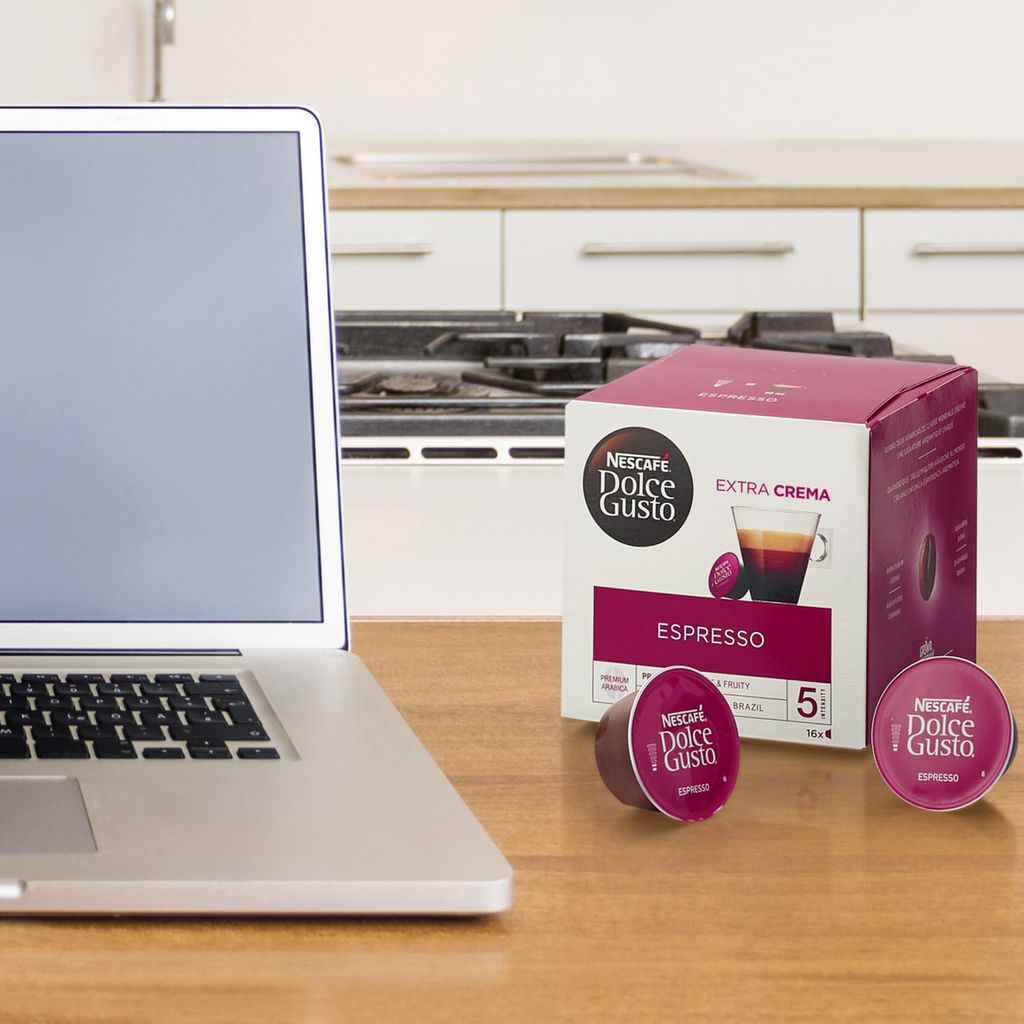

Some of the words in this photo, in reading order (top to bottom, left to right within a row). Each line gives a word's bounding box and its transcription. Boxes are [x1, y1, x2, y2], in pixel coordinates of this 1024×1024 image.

[698, 392, 778, 402] ESPRESSO
[598, 469, 676, 499] Dolce
[716, 479, 770, 496] EXTRA
[773, 484, 831, 502] CREMA
[599, 493, 676, 521] Gusto
[657, 622, 765, 648] ESPRESSO
[600, 674, 629, 684] PREMIUM
[600, 683, 629, 692] ARABICA
[716, 679, 722, 687] &
[723, 680, 751, 690] FRUITY
[733, 701, 764, 712] BRAZIL
[797, 686, 818, 719] 5
[806, 729, 824, 739] 16x
[907, 714, 975, 737] Dolce
[658, 726, 714, 753] Dolce
[907, 735, 975, 758] Gusto
[663, 746, 717, 772] Gusto
[918, 772, 959, 782] ESPRESSO
[678, 783, 710, 796] ESPRESSO
